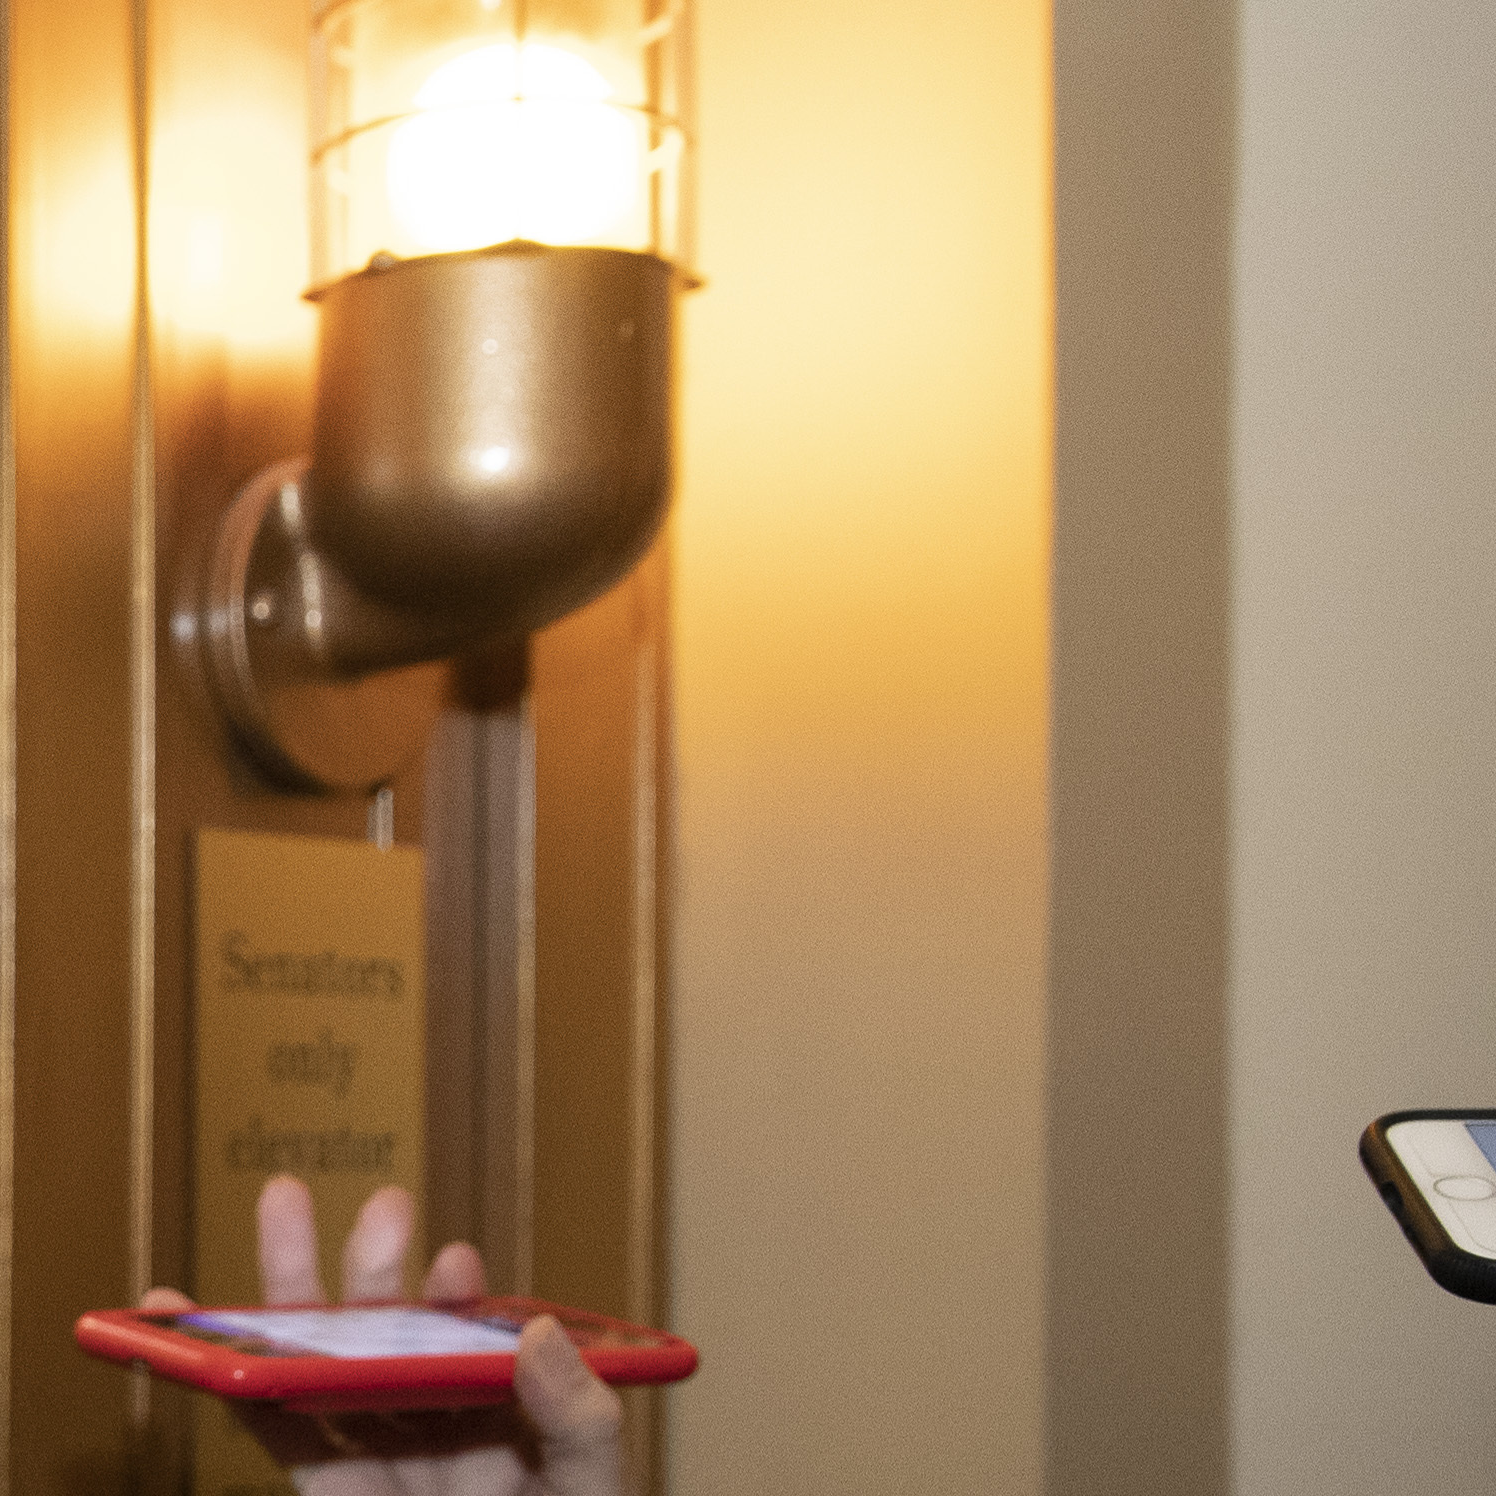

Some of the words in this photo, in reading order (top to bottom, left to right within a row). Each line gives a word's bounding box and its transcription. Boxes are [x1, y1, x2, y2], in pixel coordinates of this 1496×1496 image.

[218, 929, 404, 999] Senators
[266, 1026, 360, 1100] only
[223, 1113, 395, 1173] elevator
